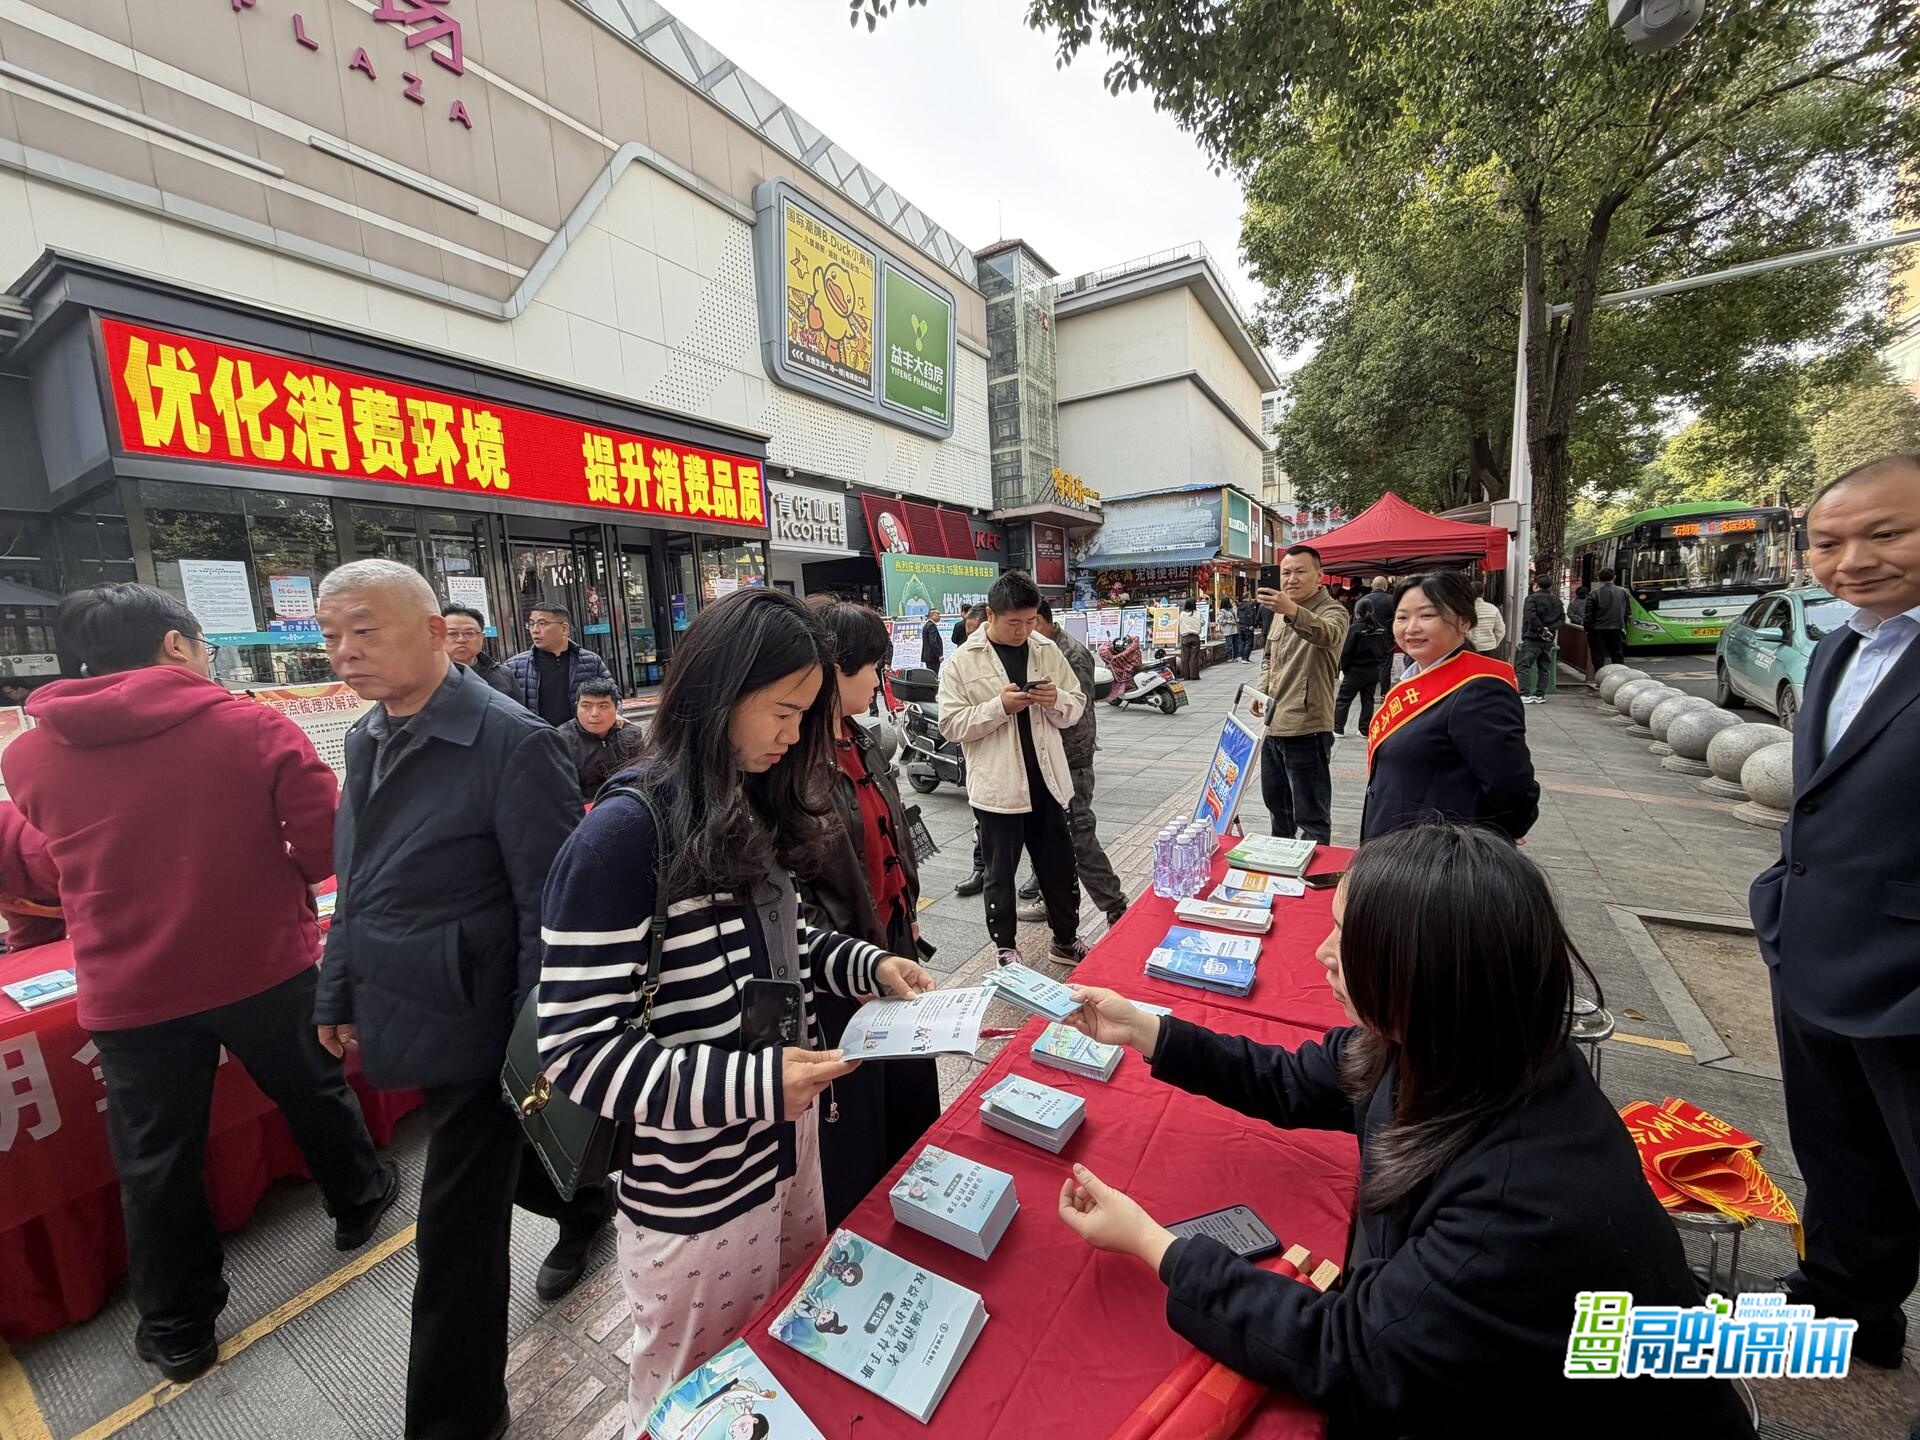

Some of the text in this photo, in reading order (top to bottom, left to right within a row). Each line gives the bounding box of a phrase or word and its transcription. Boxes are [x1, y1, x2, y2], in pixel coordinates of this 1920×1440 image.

[231, 0, 473, 130] LAZA
[890, 343, 944, 386] 益丰大药房
[890, 365, 943, 396] YIFENG PHARMACY
[124, 334, 763, 523] 优化消费环境 提升消费品质
[775, 492, 845, 525] 肯悦咖啡
[777, 519, 847, 545] KCOFFEE
[975, 531, 1001, 549] KFC
[859, 1271, 927, 1380] 权益保护教育手册
[886, 1298, 932, 1369] 金融消费者
